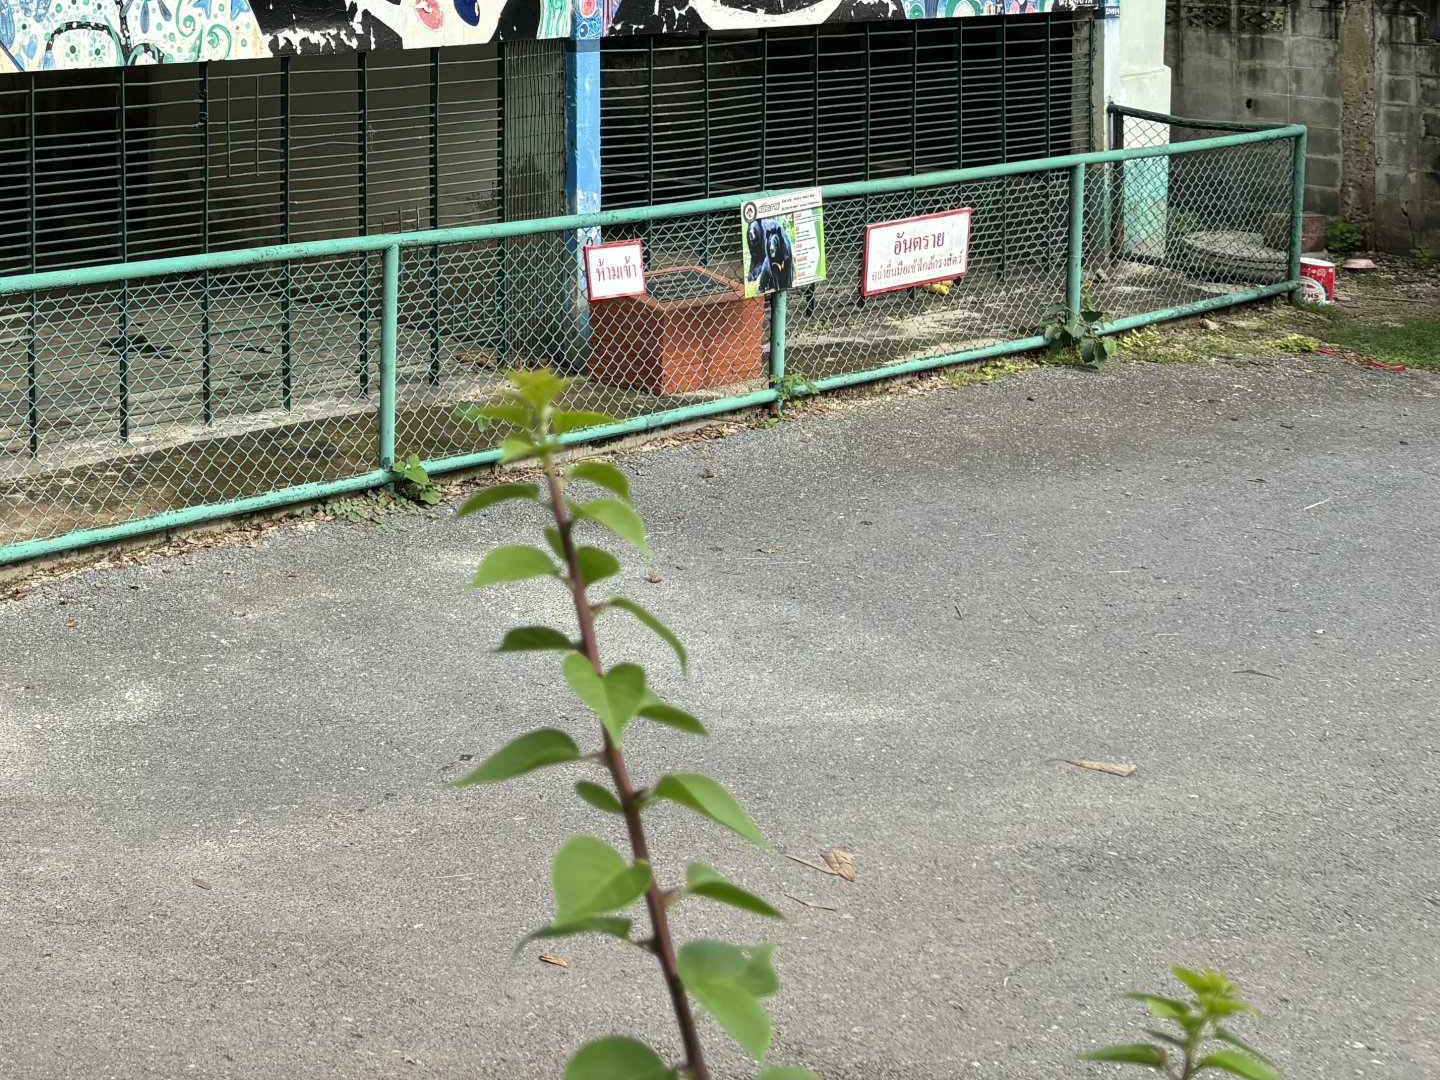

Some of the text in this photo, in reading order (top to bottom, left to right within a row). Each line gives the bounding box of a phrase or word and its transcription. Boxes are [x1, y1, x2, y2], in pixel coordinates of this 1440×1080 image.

[894, 231, 945, 256] อันตราย
[596, 256, 637, 282] ห้ามเข้า
